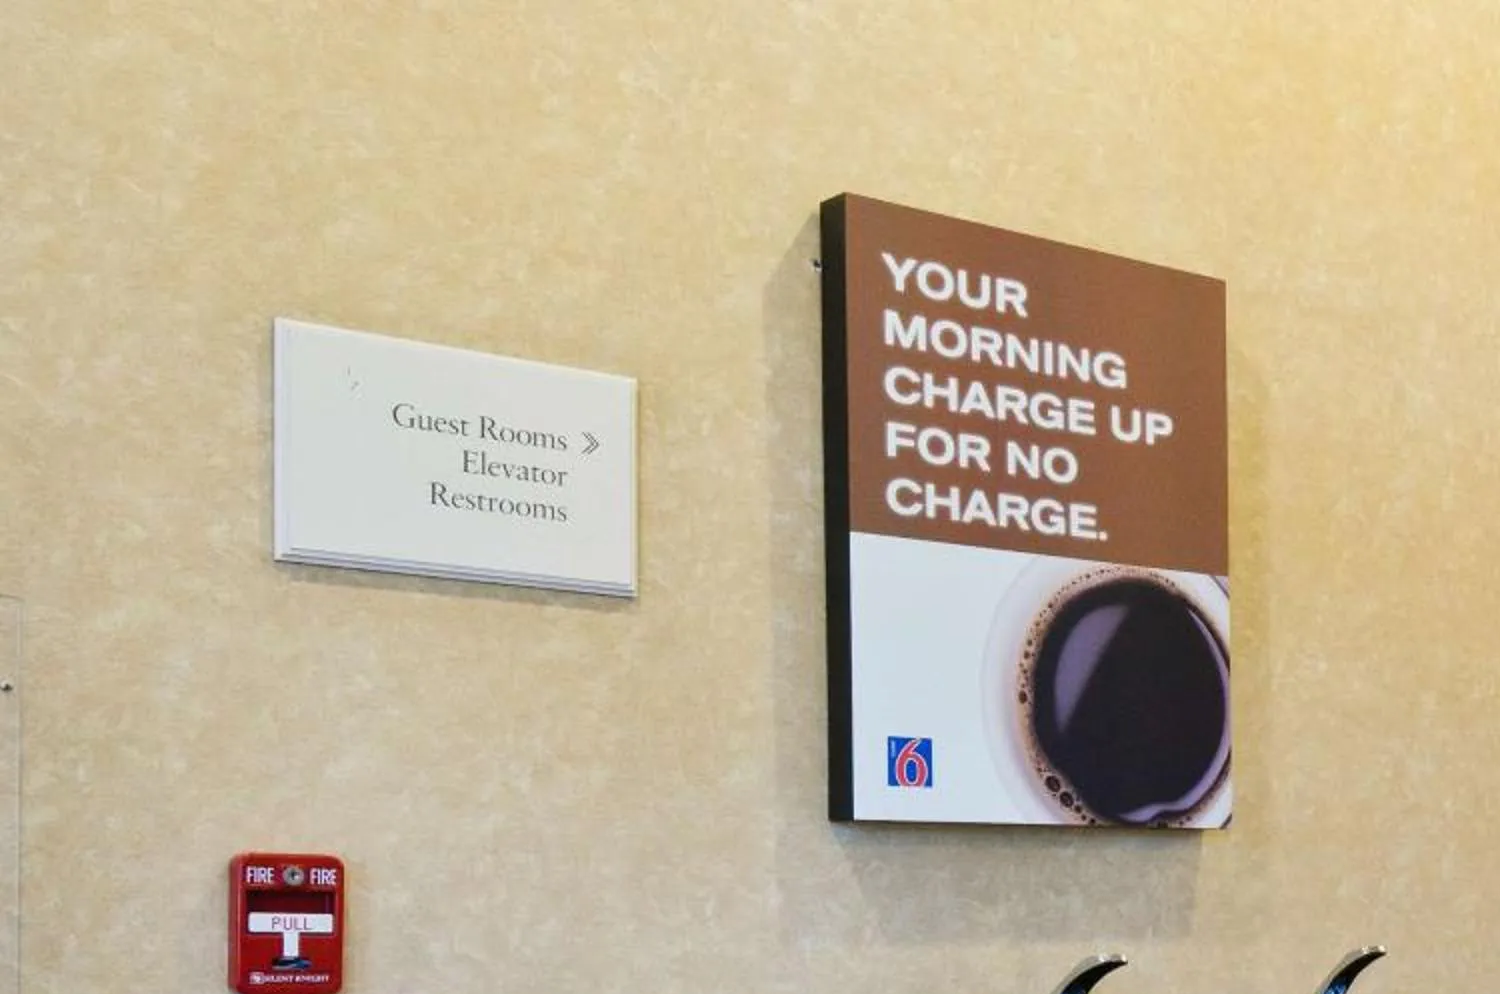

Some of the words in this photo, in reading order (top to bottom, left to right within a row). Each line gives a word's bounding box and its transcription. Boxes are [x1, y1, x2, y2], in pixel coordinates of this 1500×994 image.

[881, 250, 1029, 318] YOUR
[883, 310, 1128, 390] MORNING
[392, 402, 469, 436] Guest
[479, 415, 568, 451] Rooms
[883, 366, 1096, 436] CHARGE
[1110, 406, 1174, 446] UP
[462, 449, 568, 487] Elevator
[885, 421, 990, 472] FOR
[1006, 439, 1079, 484] NO
[430, 481, 568, 523] Restrooms
[885, 478, 1108, 541] CHARGE.
[895, 738, 929, 787] 6
[246, 866, 275, 884] FIRE
[310, 868, 337, 885] FIRE
[271, 916, 312, 931] PULL
